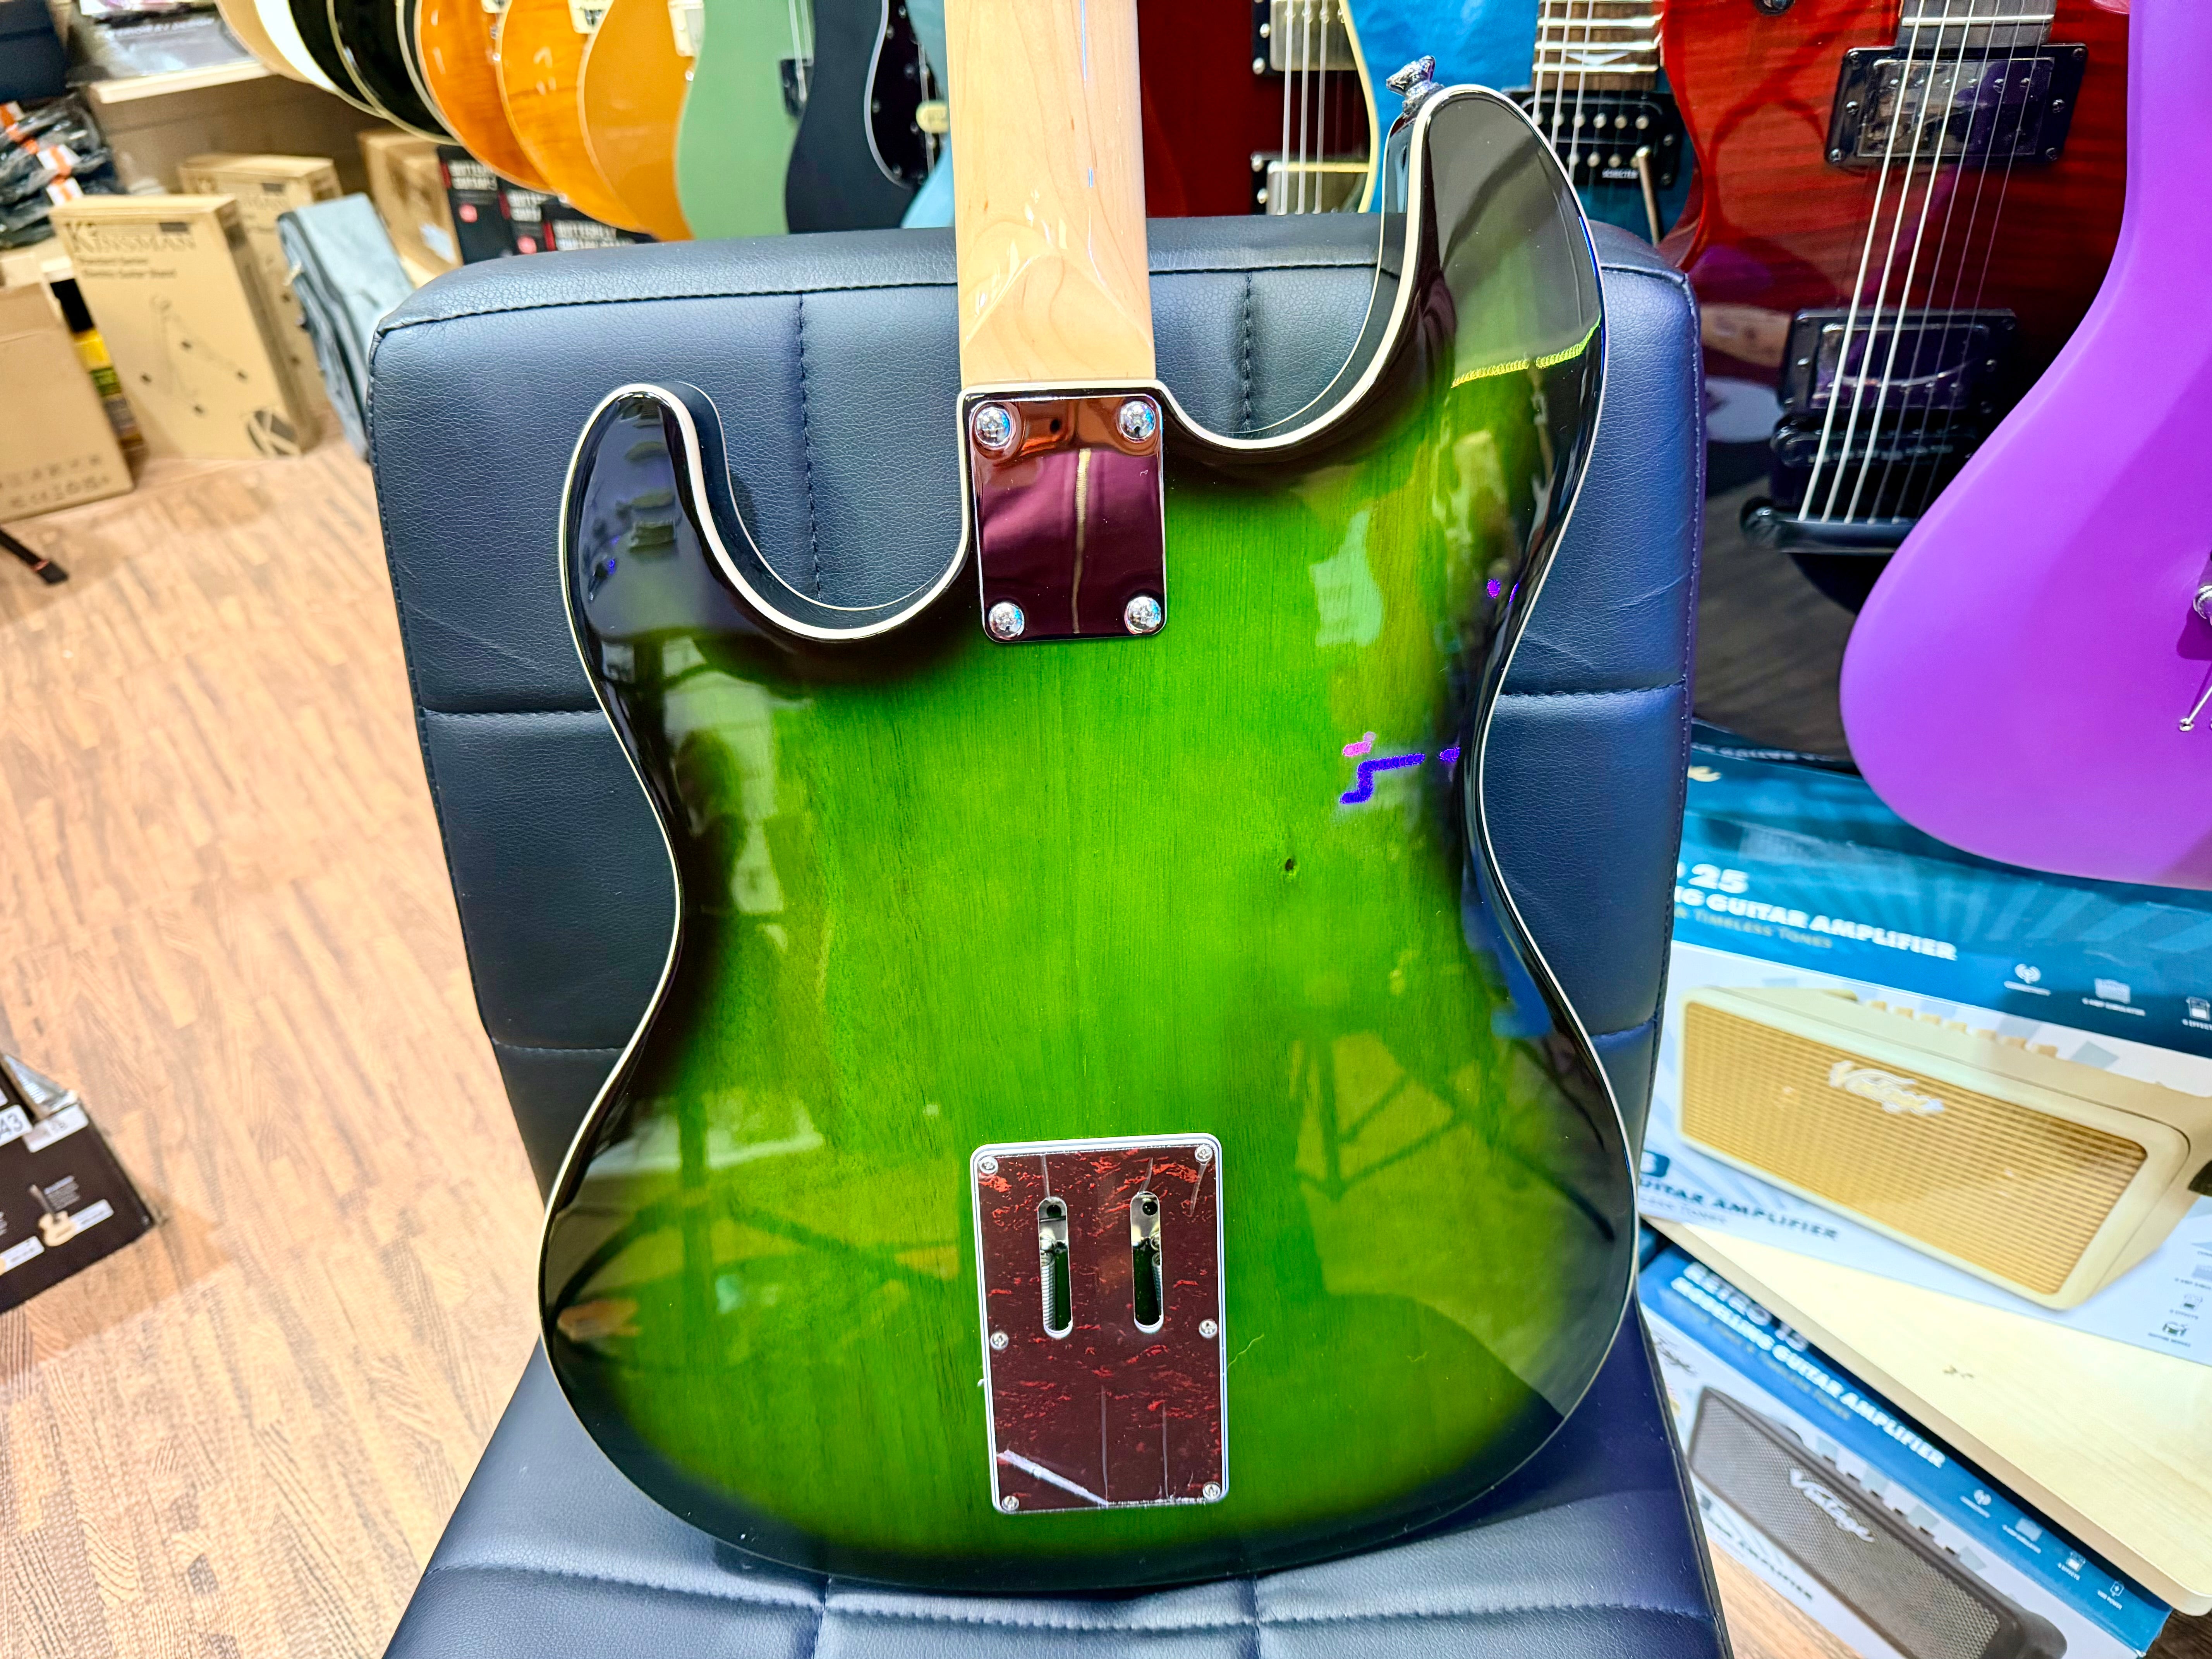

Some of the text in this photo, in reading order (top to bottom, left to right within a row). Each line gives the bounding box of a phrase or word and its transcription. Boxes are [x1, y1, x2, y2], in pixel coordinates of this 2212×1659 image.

[1688, 863, 1750, 894] 25
[1706, 893, 1809, 929] GUITAR
[1809, 915, 1958, 961] AMPLIFIER
[1712, 1198, 1838, 1241] AMPLIFIER
[1772, 1344, 1844, 1398] GUITAR
[1839, 1392, 1946, 1469] AMPLIFIER
